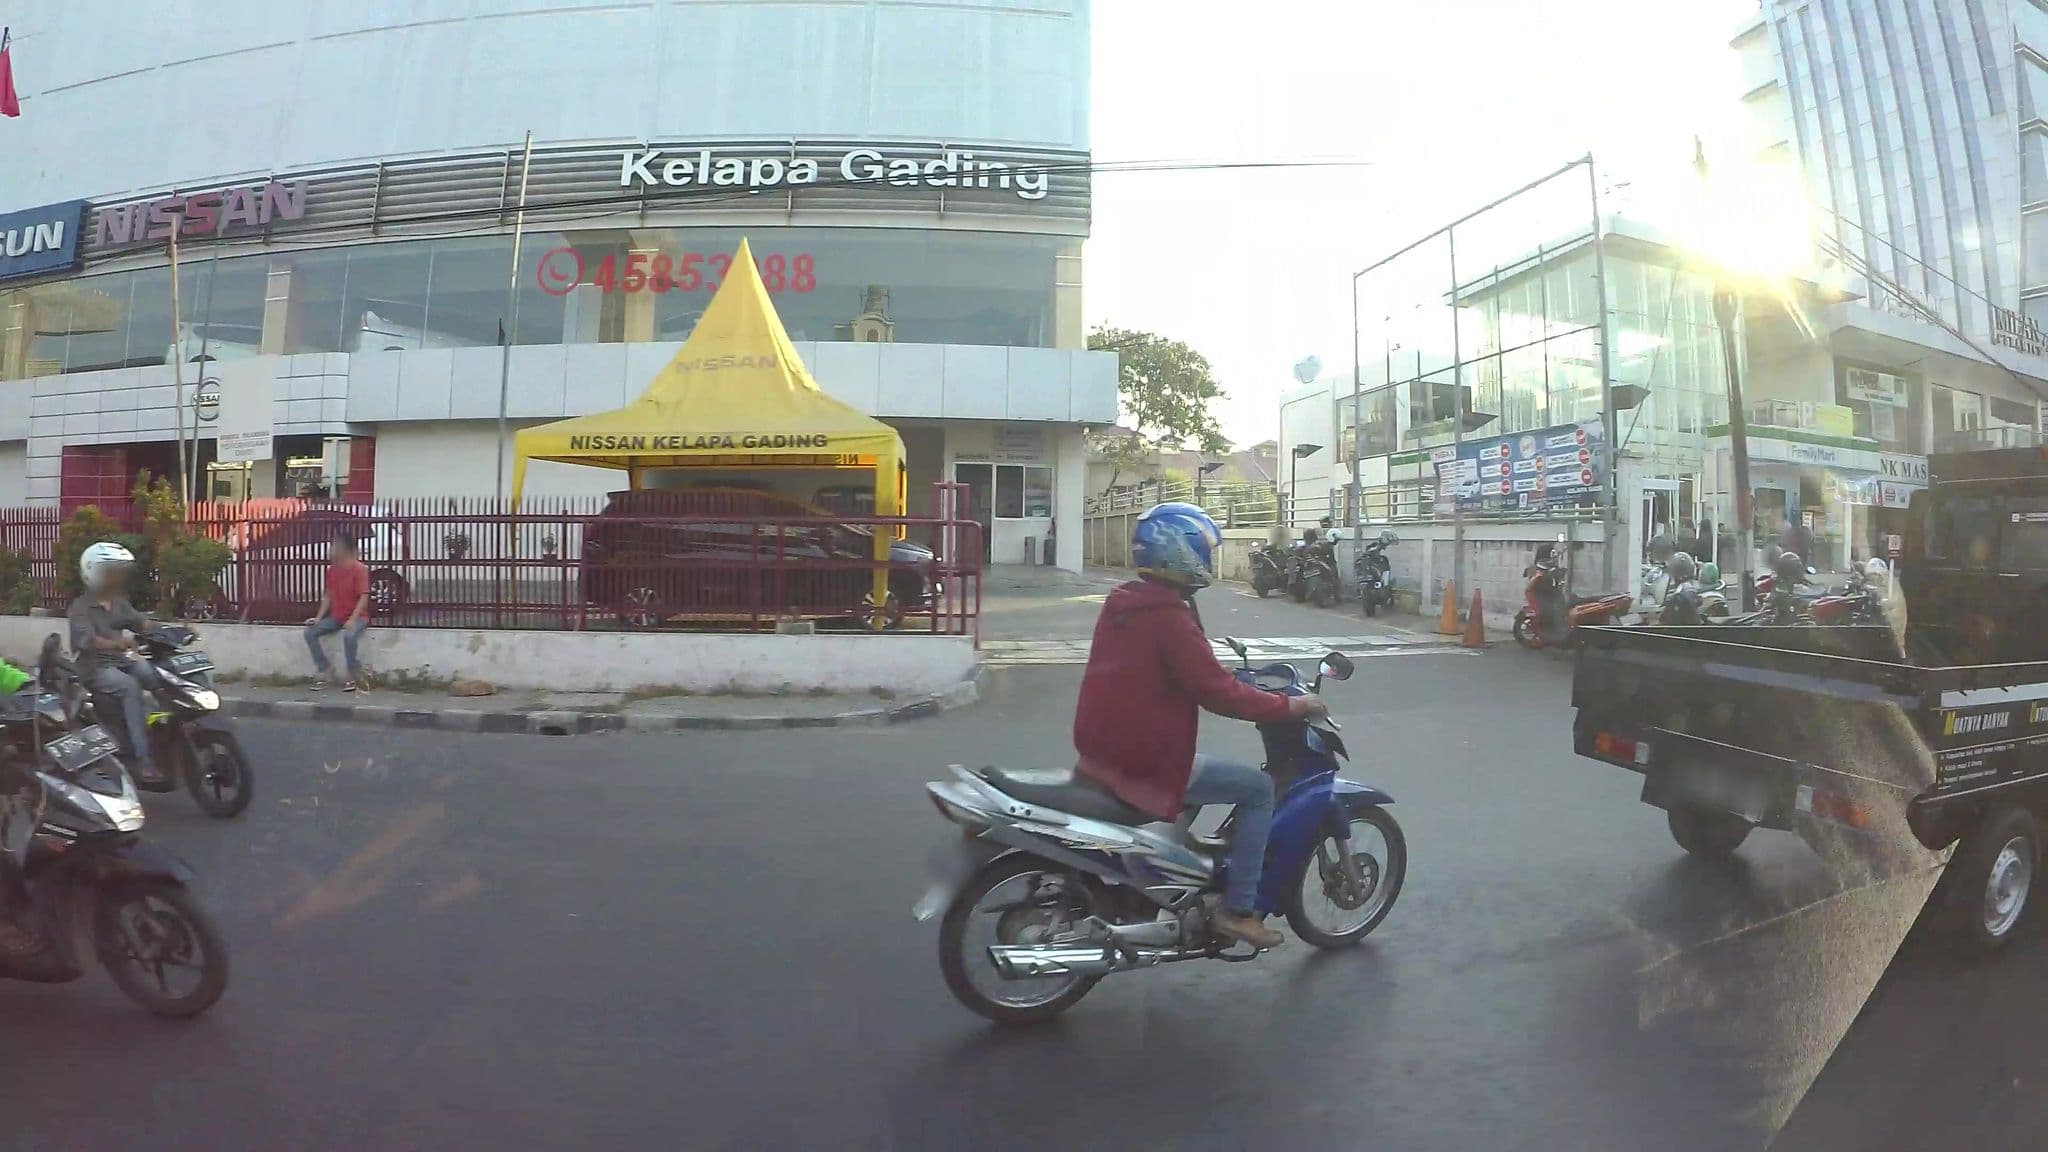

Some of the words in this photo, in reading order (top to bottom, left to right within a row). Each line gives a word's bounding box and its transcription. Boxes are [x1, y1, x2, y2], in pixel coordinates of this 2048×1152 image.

[620, 149, 818, 194] Kelapa
[840, 149, 1050, 200] Gading
[96, 179, 308, 246] NISSAN
[594, 252, 817, 295] 4585388
[676, 353, 778, 374] NISSAN
[570, 435, 646, 450] NISSAN
[652, 434, 735, 450] KELAPA
[742, 433, 828, 449] GADING
[1901, 461, 1927, 480] MAS
